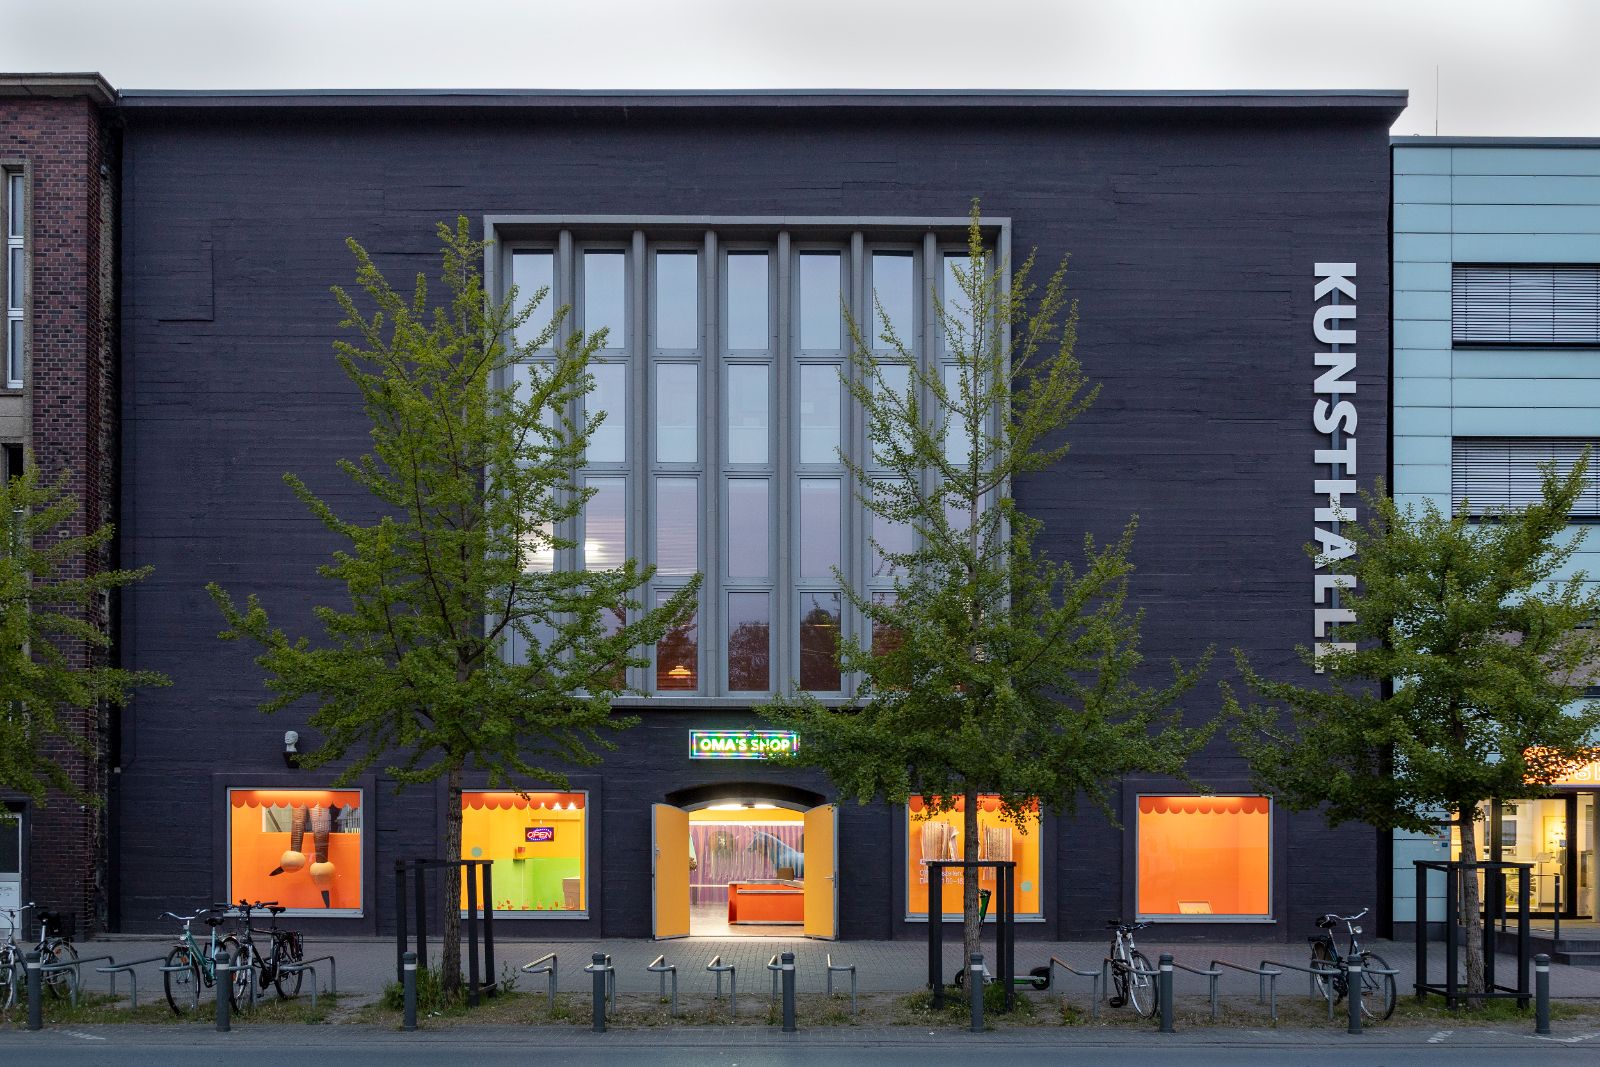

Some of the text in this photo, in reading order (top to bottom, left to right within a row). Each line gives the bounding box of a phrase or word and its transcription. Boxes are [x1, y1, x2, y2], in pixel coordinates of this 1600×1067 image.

[700, 738, 791, 751] OMA'S SHOP
[527, 831, 552, 839] OPEN
